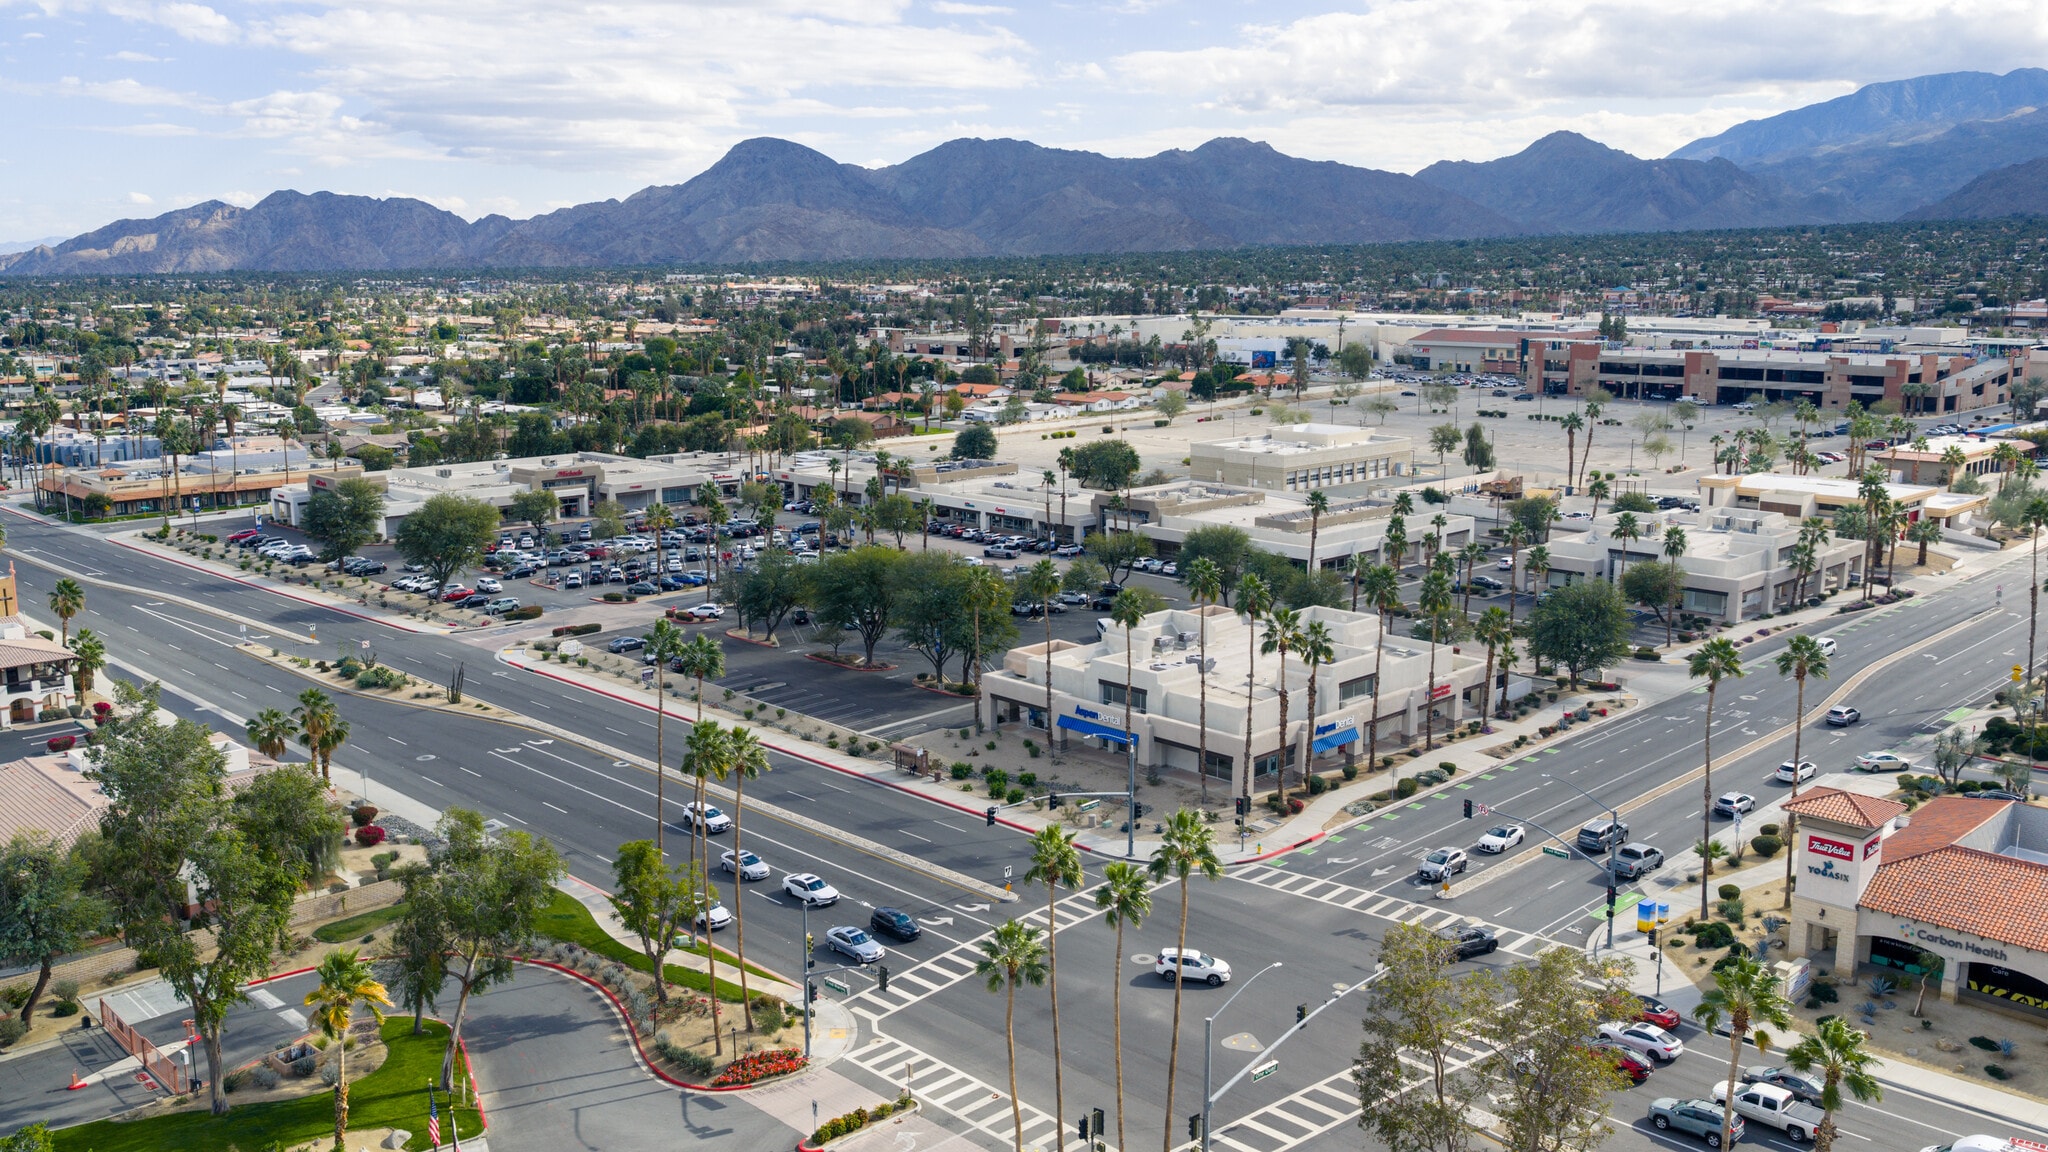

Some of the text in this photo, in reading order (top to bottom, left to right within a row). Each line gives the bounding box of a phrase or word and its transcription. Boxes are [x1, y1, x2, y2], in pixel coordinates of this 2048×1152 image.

[1807, 865, 1850, 883] YOGASIX
[1916, 929, 2008, 962] Carbon Health
[1991, 966, 2010, 977] Care
